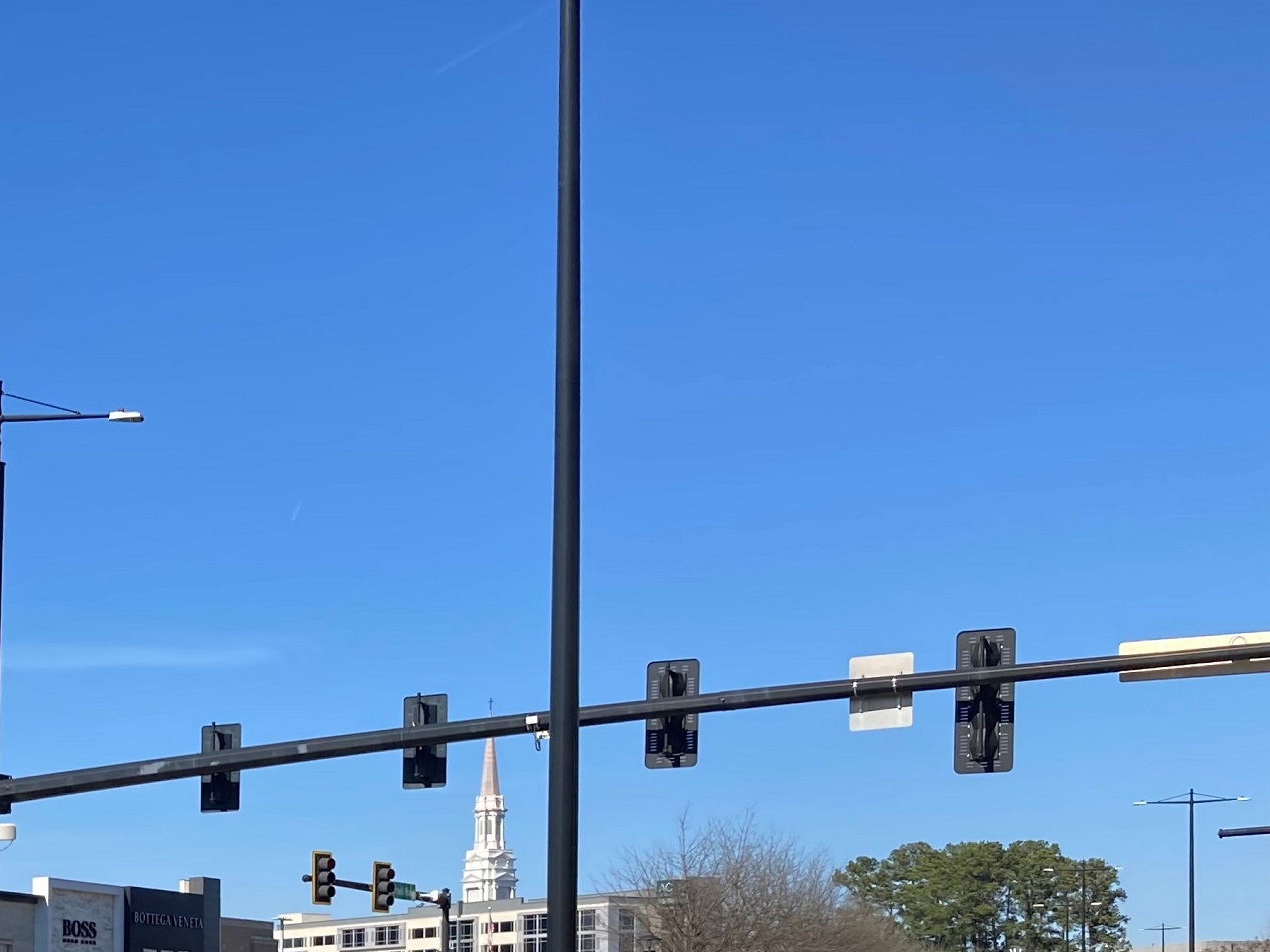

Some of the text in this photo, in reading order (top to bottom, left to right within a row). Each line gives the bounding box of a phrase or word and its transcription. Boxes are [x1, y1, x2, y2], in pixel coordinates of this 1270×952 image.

[62, 919, 97, 939] BOSS
[134, 911, 204, 929] BOTTEGA VENETA
